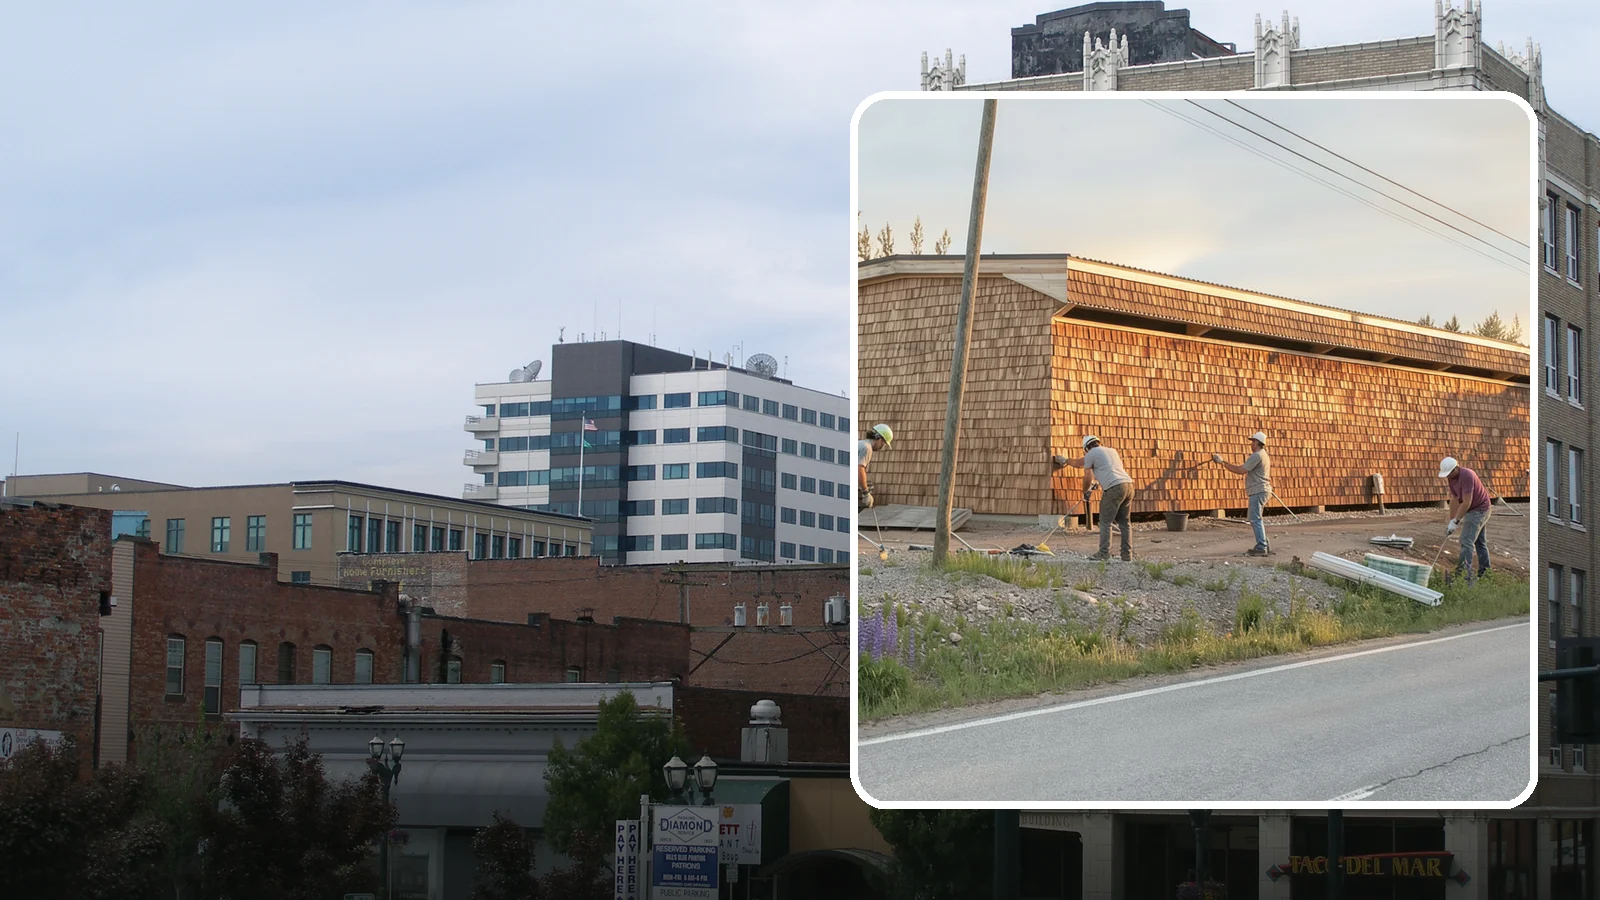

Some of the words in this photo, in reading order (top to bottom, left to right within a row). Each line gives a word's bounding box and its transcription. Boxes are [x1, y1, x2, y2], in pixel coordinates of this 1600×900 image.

[371, 566, 427, 577] Furnishers
[660, 818, 713, 833] DIAMOND
[1022, 815, 1070, 828] BUILDING
[617, 824, 625, 853] PAY
[629, 824, 637, 853] PAY
[656, 845, 688, 853] RESERVED
[689, 846, 716, 854] PARKING
[671, 862, 701, 870] PATRONS
[1346, 856, 1385, 875] DEL
[1393, 857, 1443, 877] MAR
[616, 856, 625, 894] HERE
[628, 856, 636, 894] HERE
[660, 889, 682, 897] PUBLIC
[683, 890, 710, 898] PARKING
